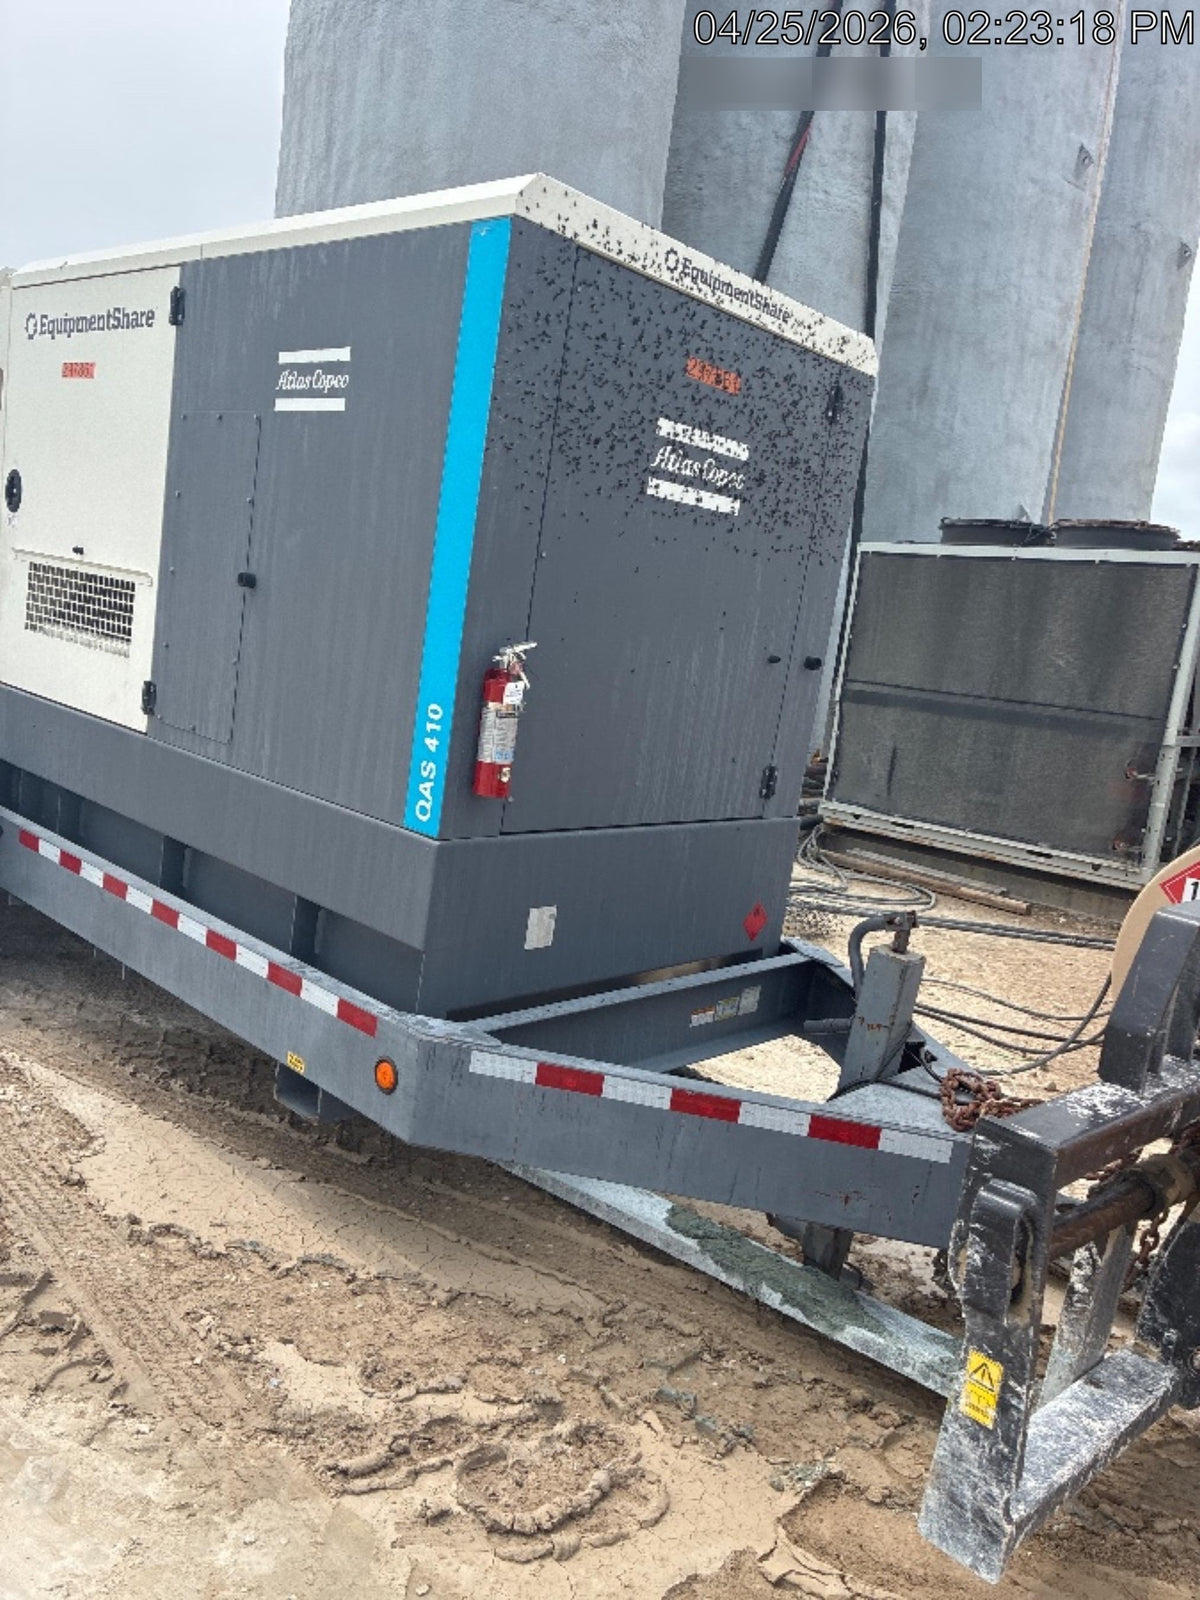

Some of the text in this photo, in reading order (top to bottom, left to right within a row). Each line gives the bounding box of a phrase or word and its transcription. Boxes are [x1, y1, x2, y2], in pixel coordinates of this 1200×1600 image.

[680, 256, 792, 324] EquipmentShare
[39, 307, 155, 340] EquipmentShare
[275, 368, 350, 394] Atlas Copco
[650, 445, 701, 478] Atlas
[415, 703, 444, 822] QAS 410
